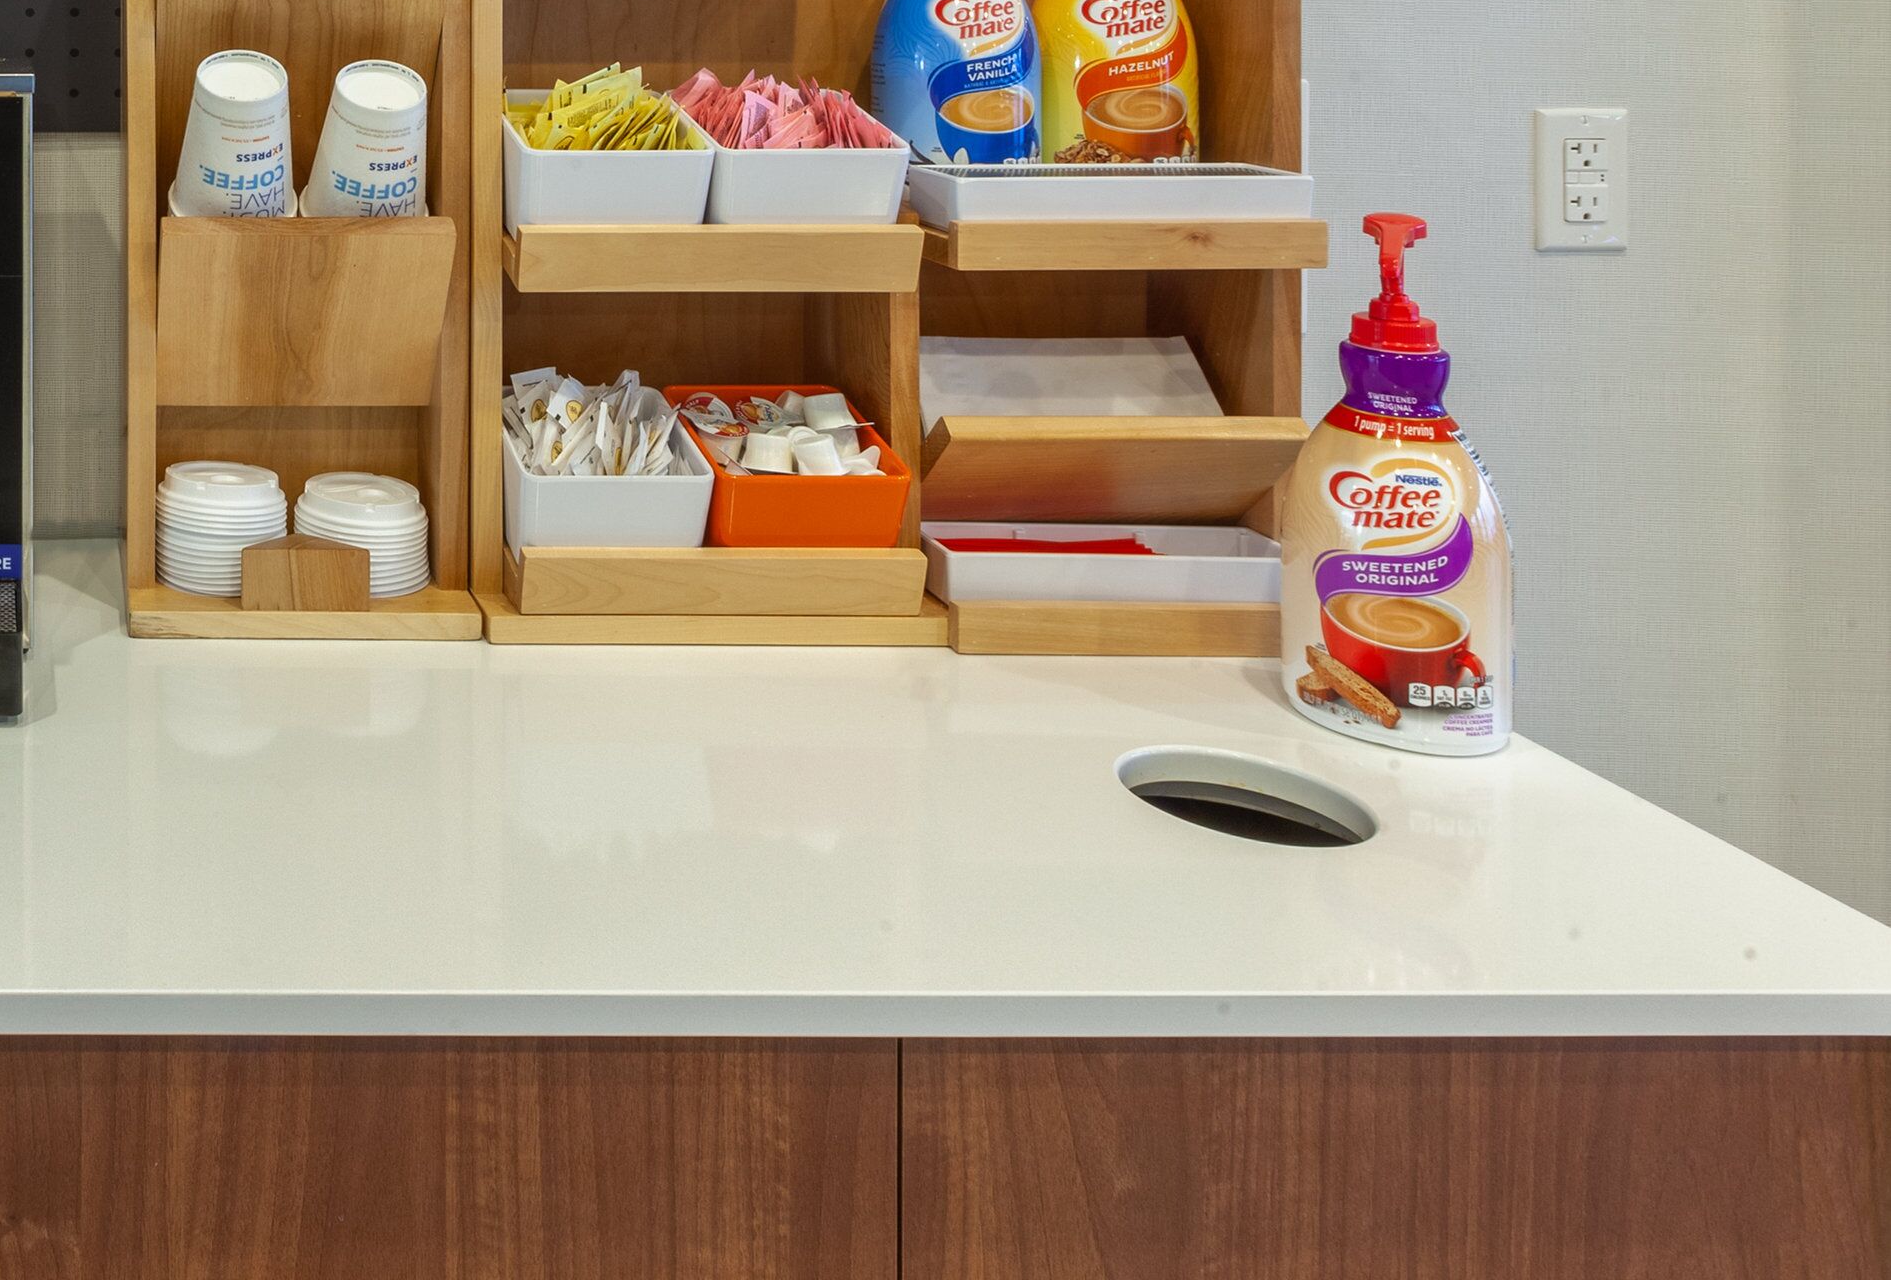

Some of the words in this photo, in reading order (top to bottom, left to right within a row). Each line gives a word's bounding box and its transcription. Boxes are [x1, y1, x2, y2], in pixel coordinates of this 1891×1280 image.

[959, 17, 1014, 39] mate
[1106, 15, 1165, 38] mate
[966, 53, 1018, 73] FRENCH
[967, 64, 1018, 82] VANILLA
[1108, 50, 1174, 77] HAZELNUT
[236, 142, 284, 163] EXPRESS
[369, 155, 418, 172] EXPRESS
[199, 164, 285, 191] COFFEE.
[332, 170, 417, 200] COFFEE.
[225, 181, 285, 210] HAVE.
[1367, 392, 1418, 405] SWEETENED
[1372, 400, 1414, 412] ORIGINAL
[1354, 415, 1359, 426] 1
[1359, 420, 1386, 433] pump
[1396, 422, 1401, 434] 1
[1403, 423, 1435, 440] serving
[1328, 470, 1441, 510] Coffee
[1352, 509, 1435, 529] mate
[1342, 556, 1448, 573] SWEETENED
[1355, 573, 1439, 586] ORIGINAL
[1413, 685, 1426, 695] 25
